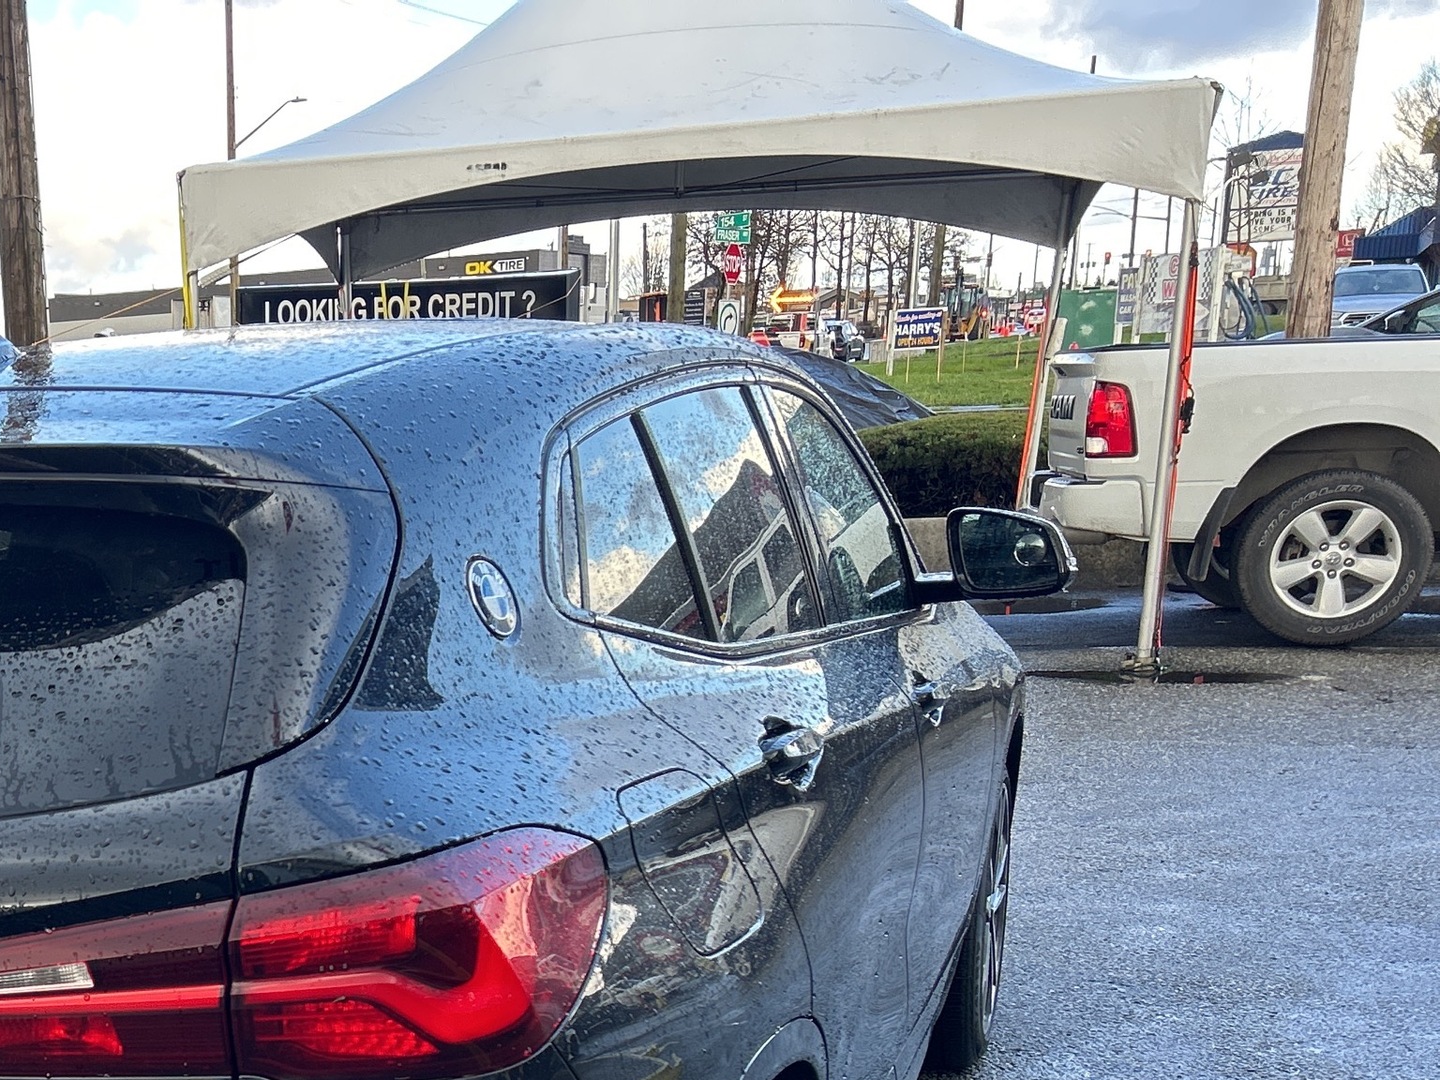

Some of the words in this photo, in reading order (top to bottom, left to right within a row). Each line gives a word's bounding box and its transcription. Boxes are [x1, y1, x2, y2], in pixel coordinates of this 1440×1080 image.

[721, 216, 735, 228] 154
[717, 229, 740, 241] FRASER
[465, 261, 493, 275] OK
[498, 260, 523, 271] TIRE
[725, 255, 741, 273] STOP
[373, 295, 421, 320] FOR
[427, 290, 516, 320] CREDIT
[895, 321, 940, 336] HARRY'S
[1258, 484, 1364, 548] WRANGLER
[1306, 569, 1417, 634] GOODYEAR
